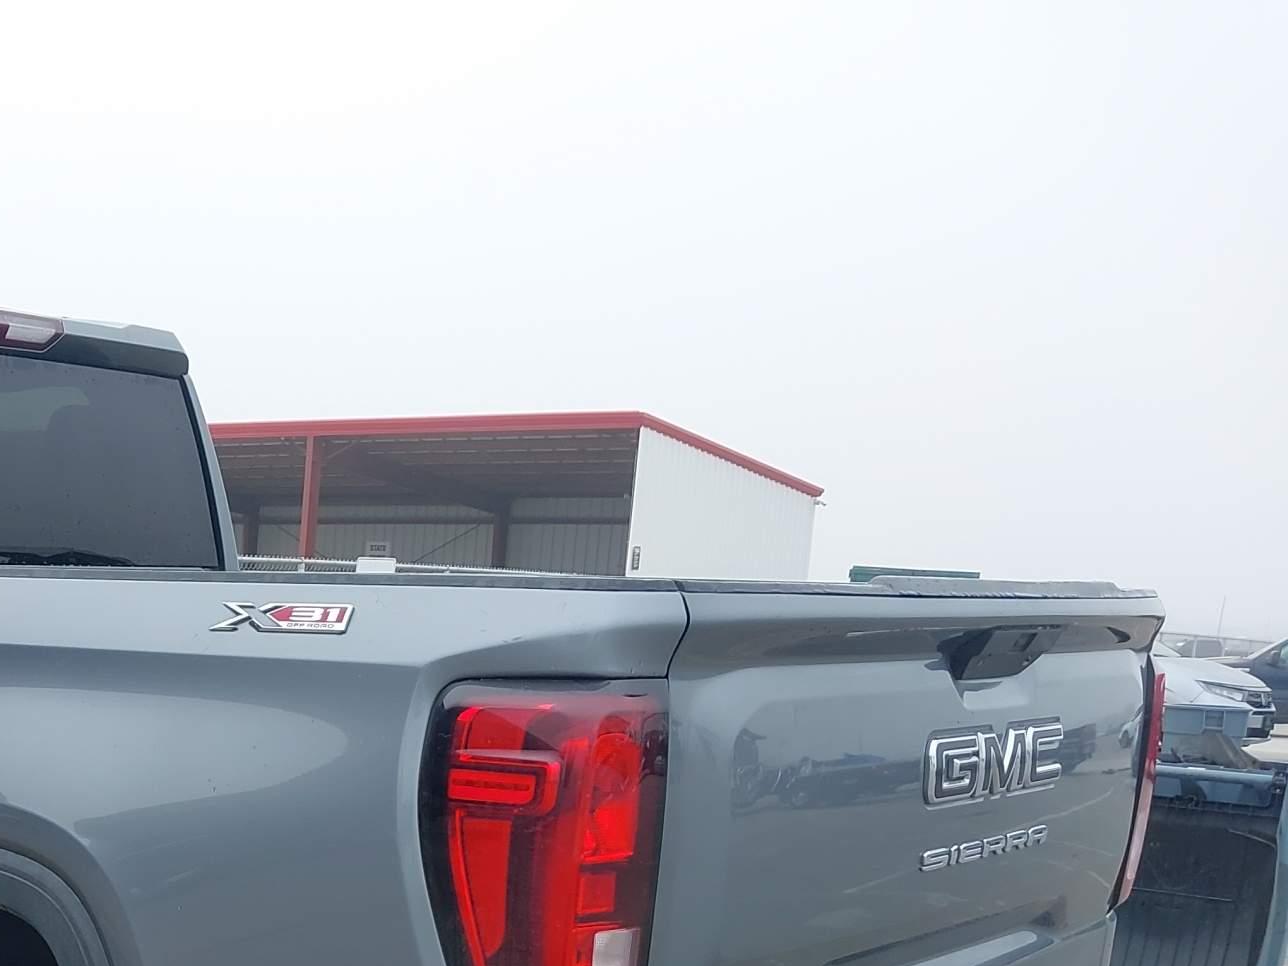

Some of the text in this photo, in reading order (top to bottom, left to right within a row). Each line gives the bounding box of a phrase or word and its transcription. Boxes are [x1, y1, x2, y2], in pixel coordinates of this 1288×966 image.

[209, 600, 355, 635] X31
[923, 720, 1063, 806] GMC
[919, 824, 1048, 872] SIERRA
